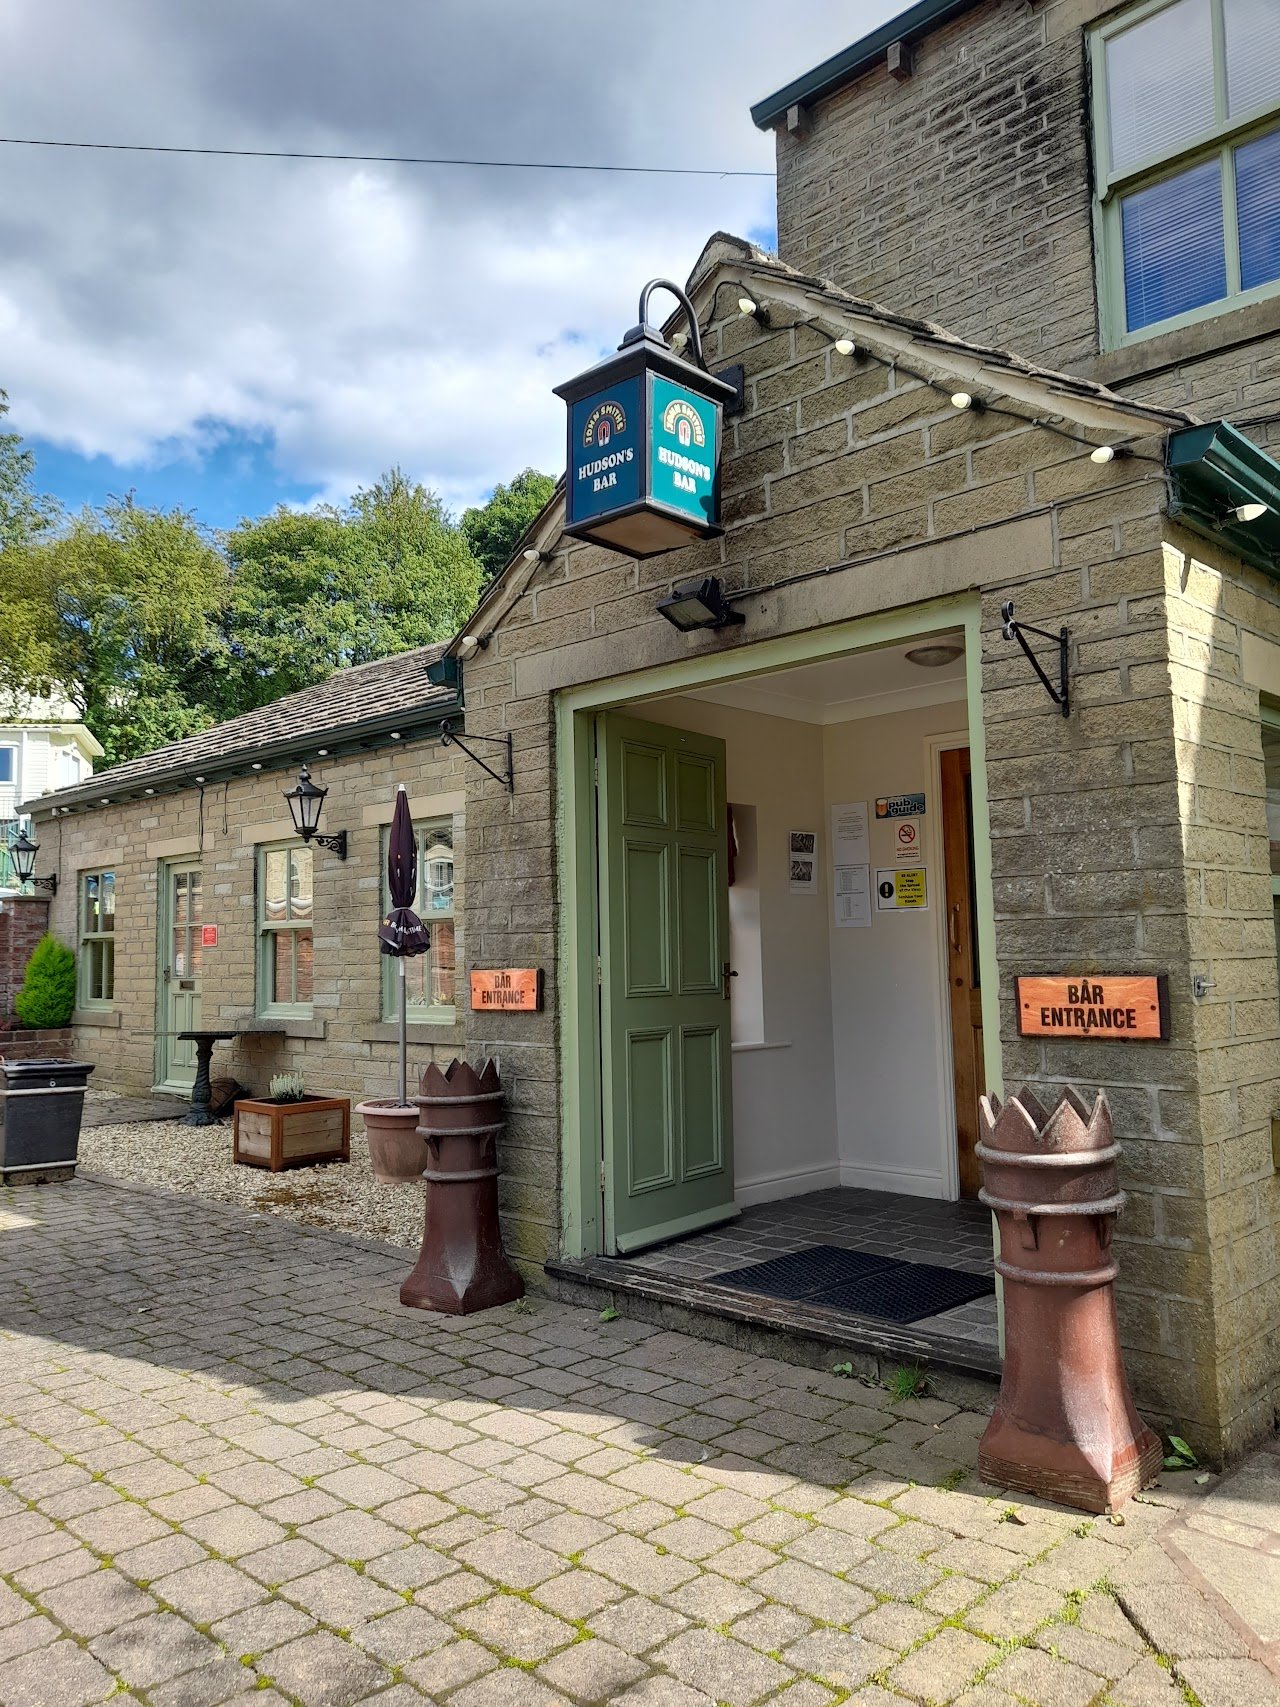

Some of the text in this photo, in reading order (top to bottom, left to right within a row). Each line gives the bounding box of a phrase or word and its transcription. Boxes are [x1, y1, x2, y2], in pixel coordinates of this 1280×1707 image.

[585, 404, 627, 443] JOHN SMITH'S
[578, 447, 634, 480] HUDSON'S
[658, 446, 711, 482] HUDSON'S
[593, 472, 617, 492] BAR
[673, 471, 697, 494] BAR
[888, 798, 911, 810] pub
[892, 802, 924, 815] guide
[494, 973, 511, 988] BAR
[481, 990, 525, 1004] ENTRANCE
[1068, 984, 1104, 1004] BAR
[1041, 1007, 1137, 1029] ENTRANCE
